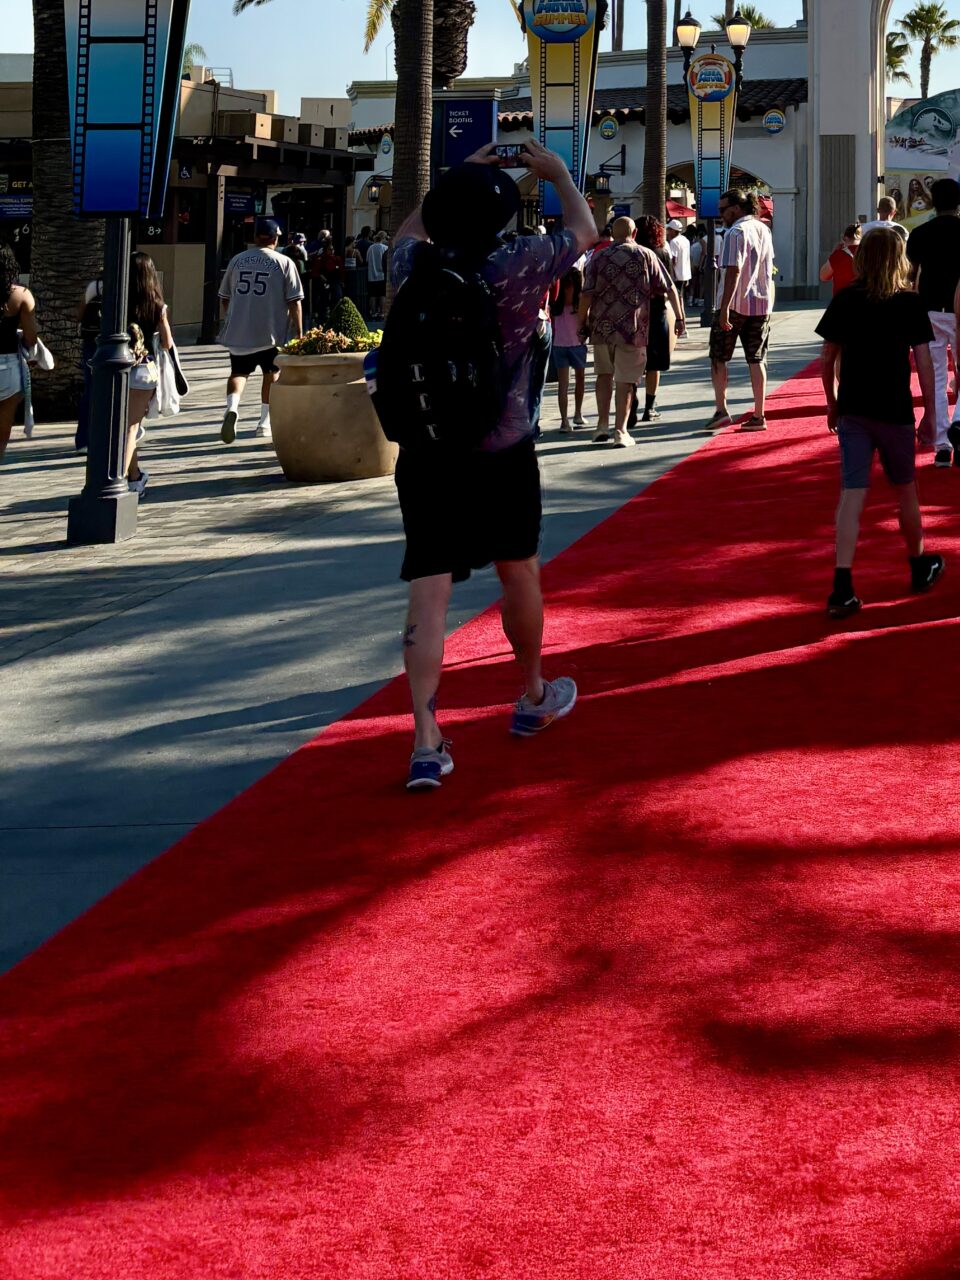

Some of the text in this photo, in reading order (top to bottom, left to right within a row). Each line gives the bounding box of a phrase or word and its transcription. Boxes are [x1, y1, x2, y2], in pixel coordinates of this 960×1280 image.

[536, 2, 585, 14] MOVIE
[533, 13, 587, 26] SUMMER
[11, 180, 27, 189] GET
[22, 223, 30, 235] 6
[147, 225, 155, 236] 8
[236, 270, 269, 296] 55
